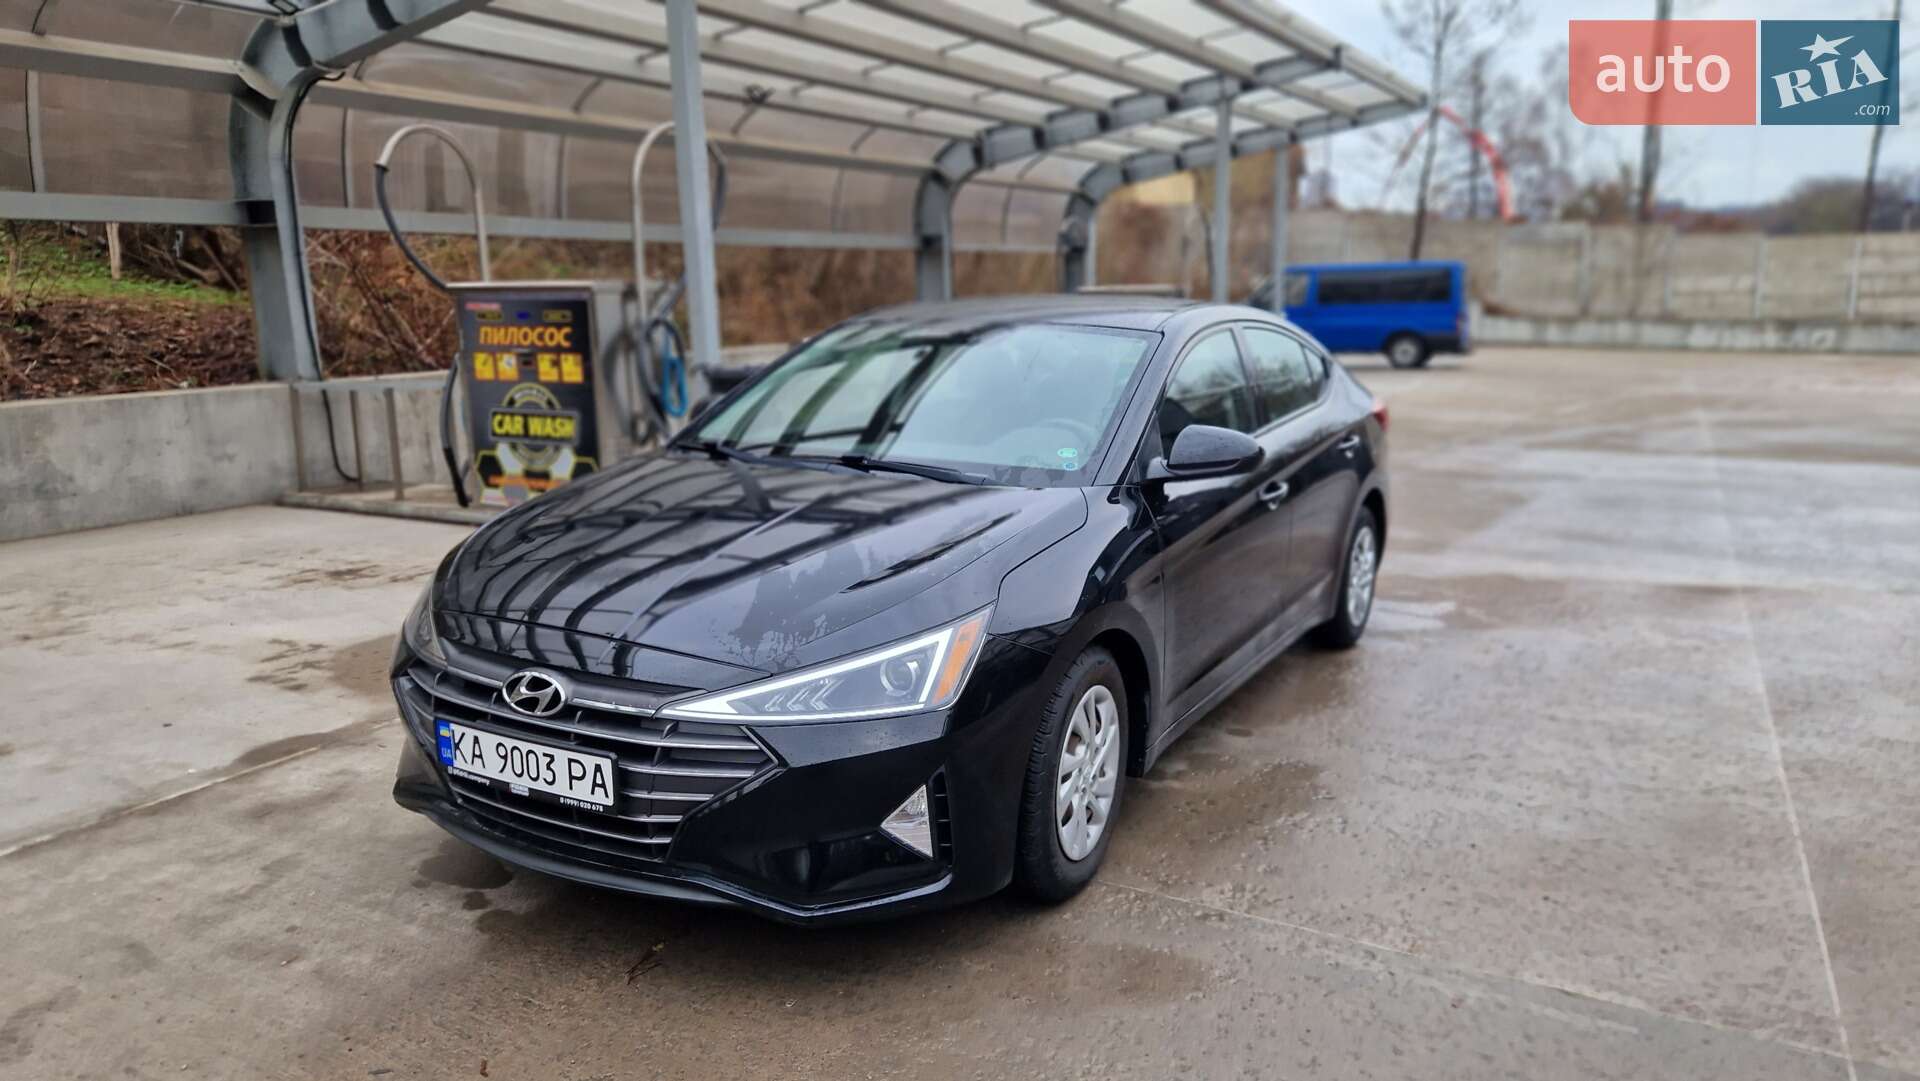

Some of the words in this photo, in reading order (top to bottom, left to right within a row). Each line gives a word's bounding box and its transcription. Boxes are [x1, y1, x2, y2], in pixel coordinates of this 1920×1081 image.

[479, 325, 572, 347] ПИЛОСОС
[492, 413, 525, 435] CAR
[527, 416, 577, 437] WASH
[441, 748, 453, 758] UA
[451, 729, 486, 769] KA
[495, 742, 557, 786] 9003
[567, 757, 610, 799] PA
